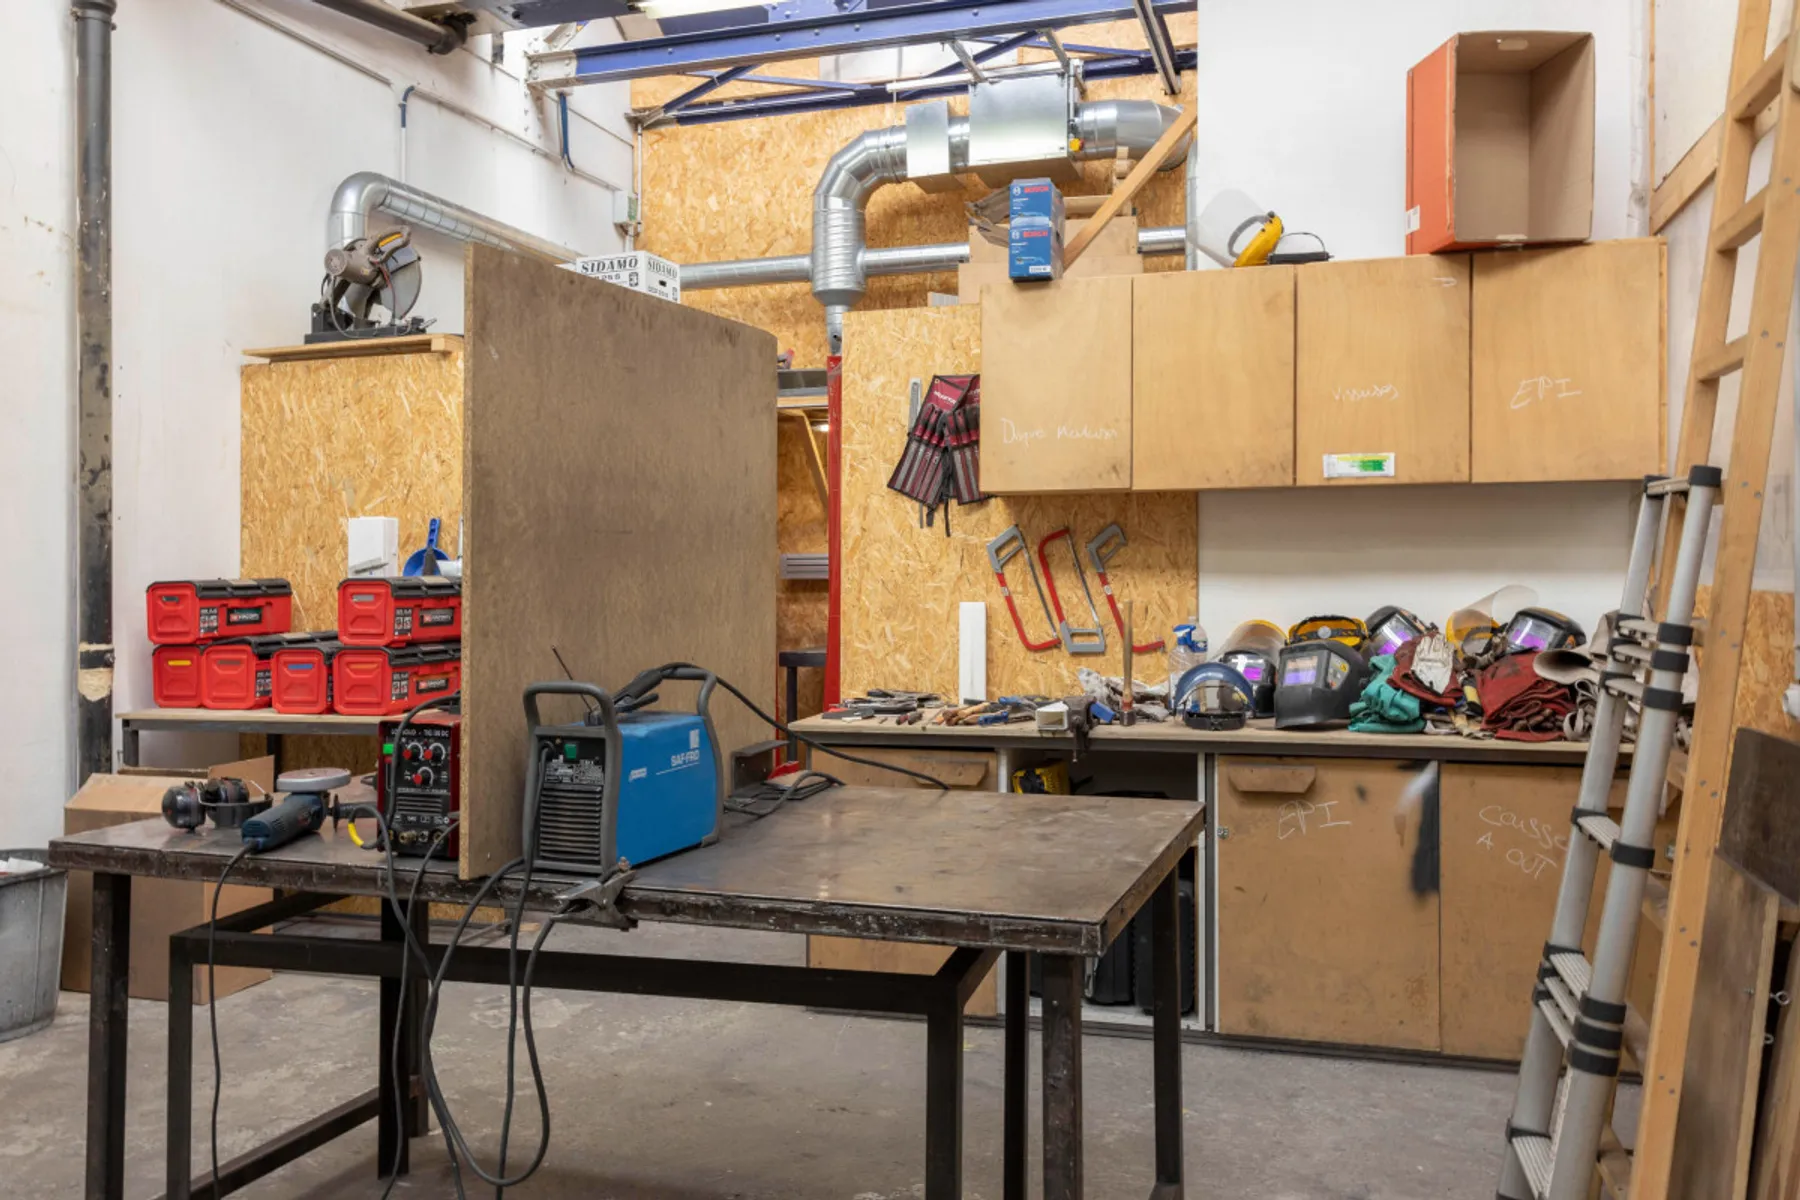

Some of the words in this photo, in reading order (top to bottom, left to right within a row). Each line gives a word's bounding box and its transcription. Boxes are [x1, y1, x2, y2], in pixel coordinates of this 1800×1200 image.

[1022, 230, 1048, 238] BOSCH
[581, 257, 638, 274] SIDAMO
[647, 259, 678, 280] SIDAMO
[1510, 375, 1583, 409] EPI
[1278, 799, 1352, 840] EPI
